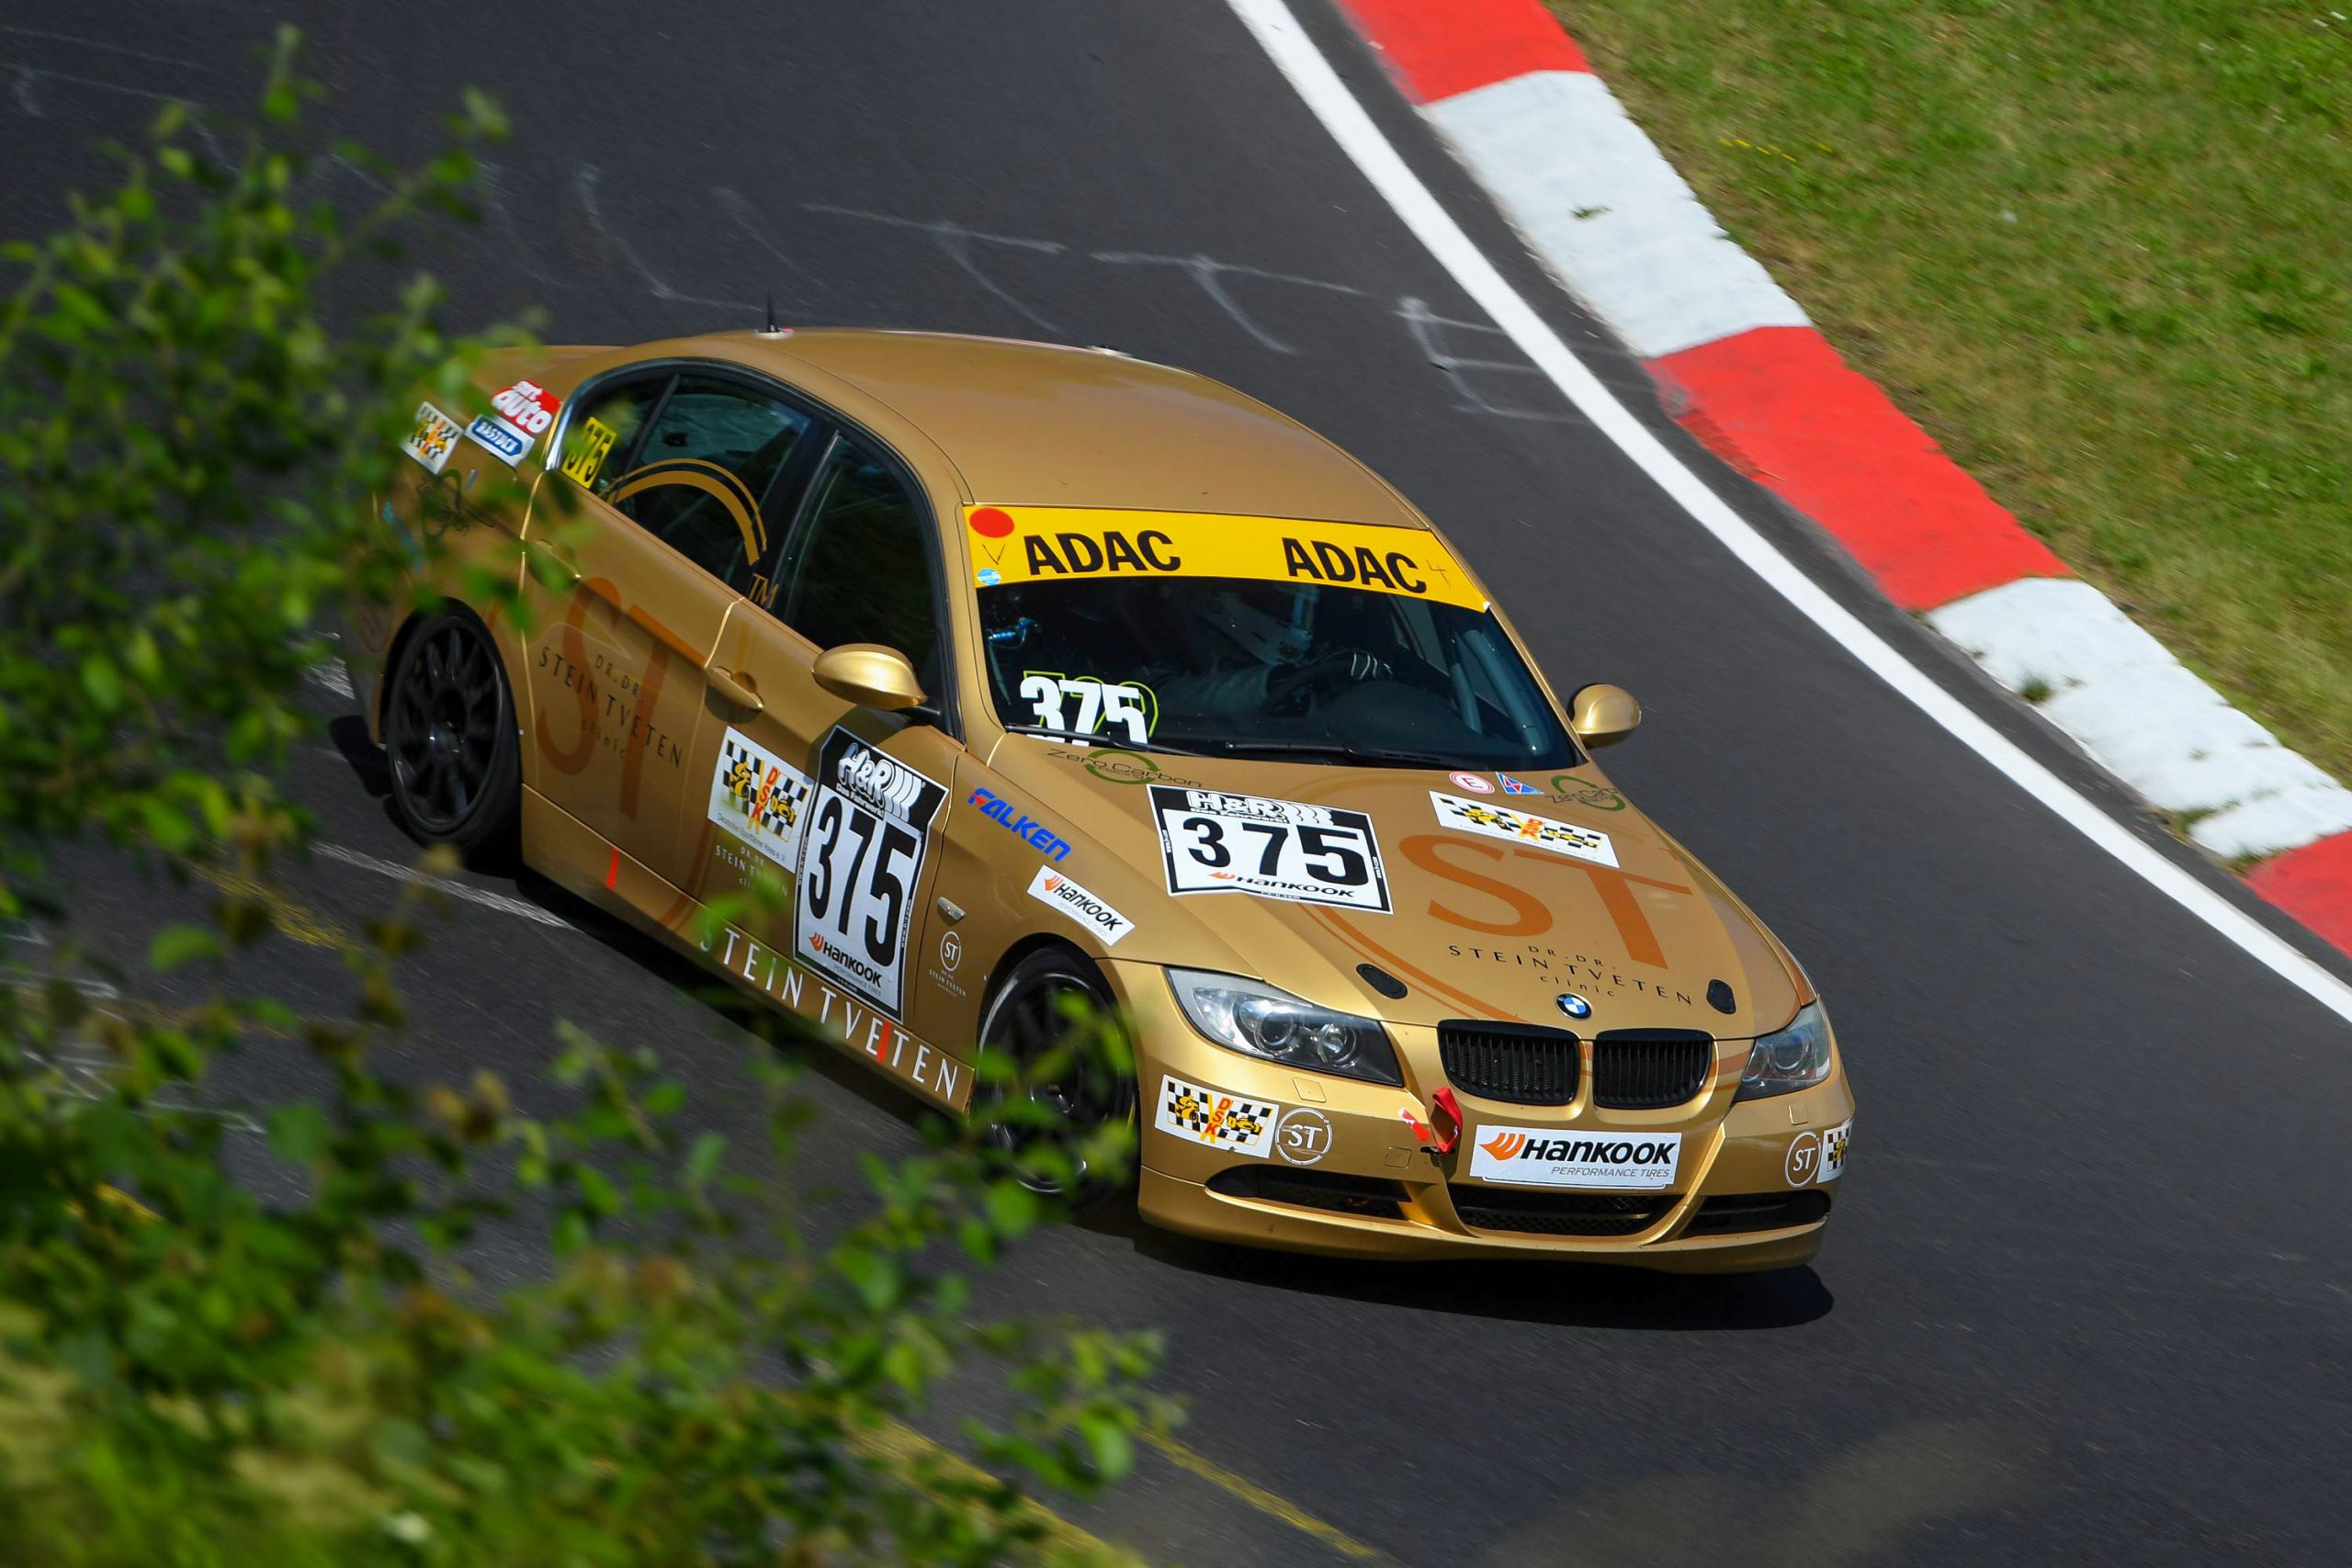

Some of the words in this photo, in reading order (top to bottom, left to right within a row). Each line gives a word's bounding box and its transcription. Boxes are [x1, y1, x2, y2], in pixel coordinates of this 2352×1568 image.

[492, 389, 553, 434] auto
[1023, 529, 1182, 576] ADAC
[1281, 536, 1428, 594] ADAC
[538, 646, 597, 703] STEIN
[605, 694, 683, 769] TVETEN
[1020, 676, 1148, 747] 375
[837, 742, 897, 809] H&R
[1186, 790, 1287, 819] H&R
[967, 787, 1073, 862] FALKEN
[1182, 817, 1369, 887] 375
[715, 844, 747, 872] STEIN
[808, 795, 919, 967] 375
[1398, 833, 1692, 970] ST
[944, 941, 959, 962] ST
[1448, 944, 1549, 970] STEIN
[1563, 963, 1692, 1006] TVETEN
[1539, 975, 1615, 998] clinic
[820, 986, 958, 1101] TVETEN
[1204, 1096, 1234, 1135] DSK
[1287, 1122, 1323, 1149] ST
[1551, 1166, 1638, 1177] PERFORMANCE
[1640, 1168, 1670, 1179] TIRES
[1792, 1146, 1816, 1172] ST
